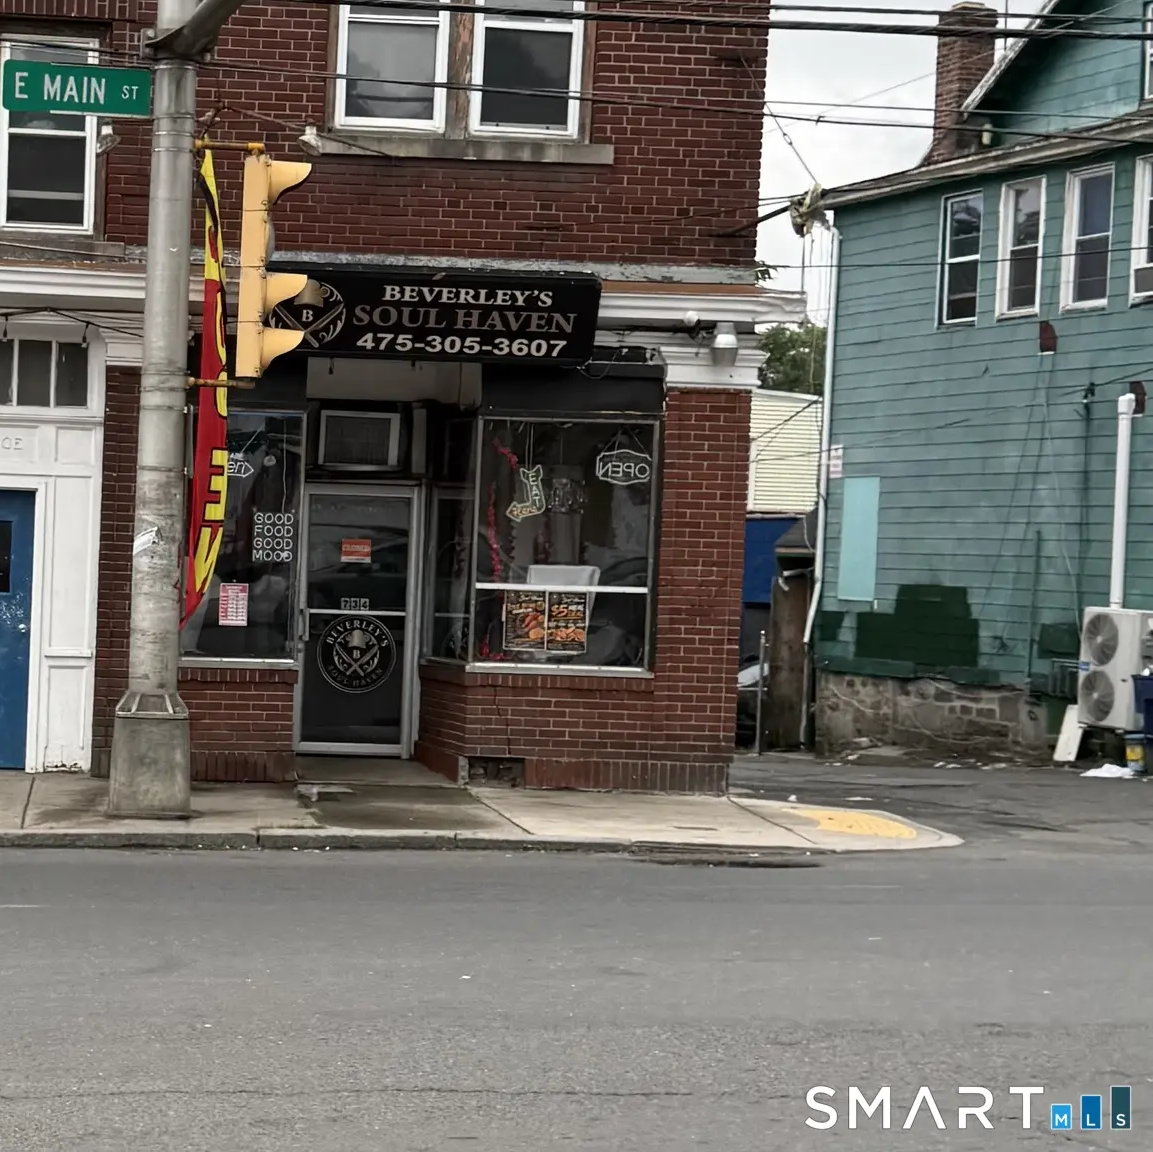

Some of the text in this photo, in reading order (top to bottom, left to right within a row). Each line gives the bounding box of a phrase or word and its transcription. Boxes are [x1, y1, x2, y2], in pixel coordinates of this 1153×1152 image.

[14, 71, 139, 105] E MAIN ST
[382, 284, 553, 307] BEVERLEY'S
[301, 309, 314, 322] B
[353, 305, 577, 334] SOUL HAVEN
[356, 332, 568, 358] 475-305-3607
[528, 472, 542, 507] EAT
[254, 513, 294, 525] GOOD
[254, 525, 294, 537] FOOD
[253, 538, 293, 549] GOOD
[252, 550, 293, 563] MOOD
[341, 598, 369, 610] 734
[326, 619, 389, 647] BEVERLEY'S
